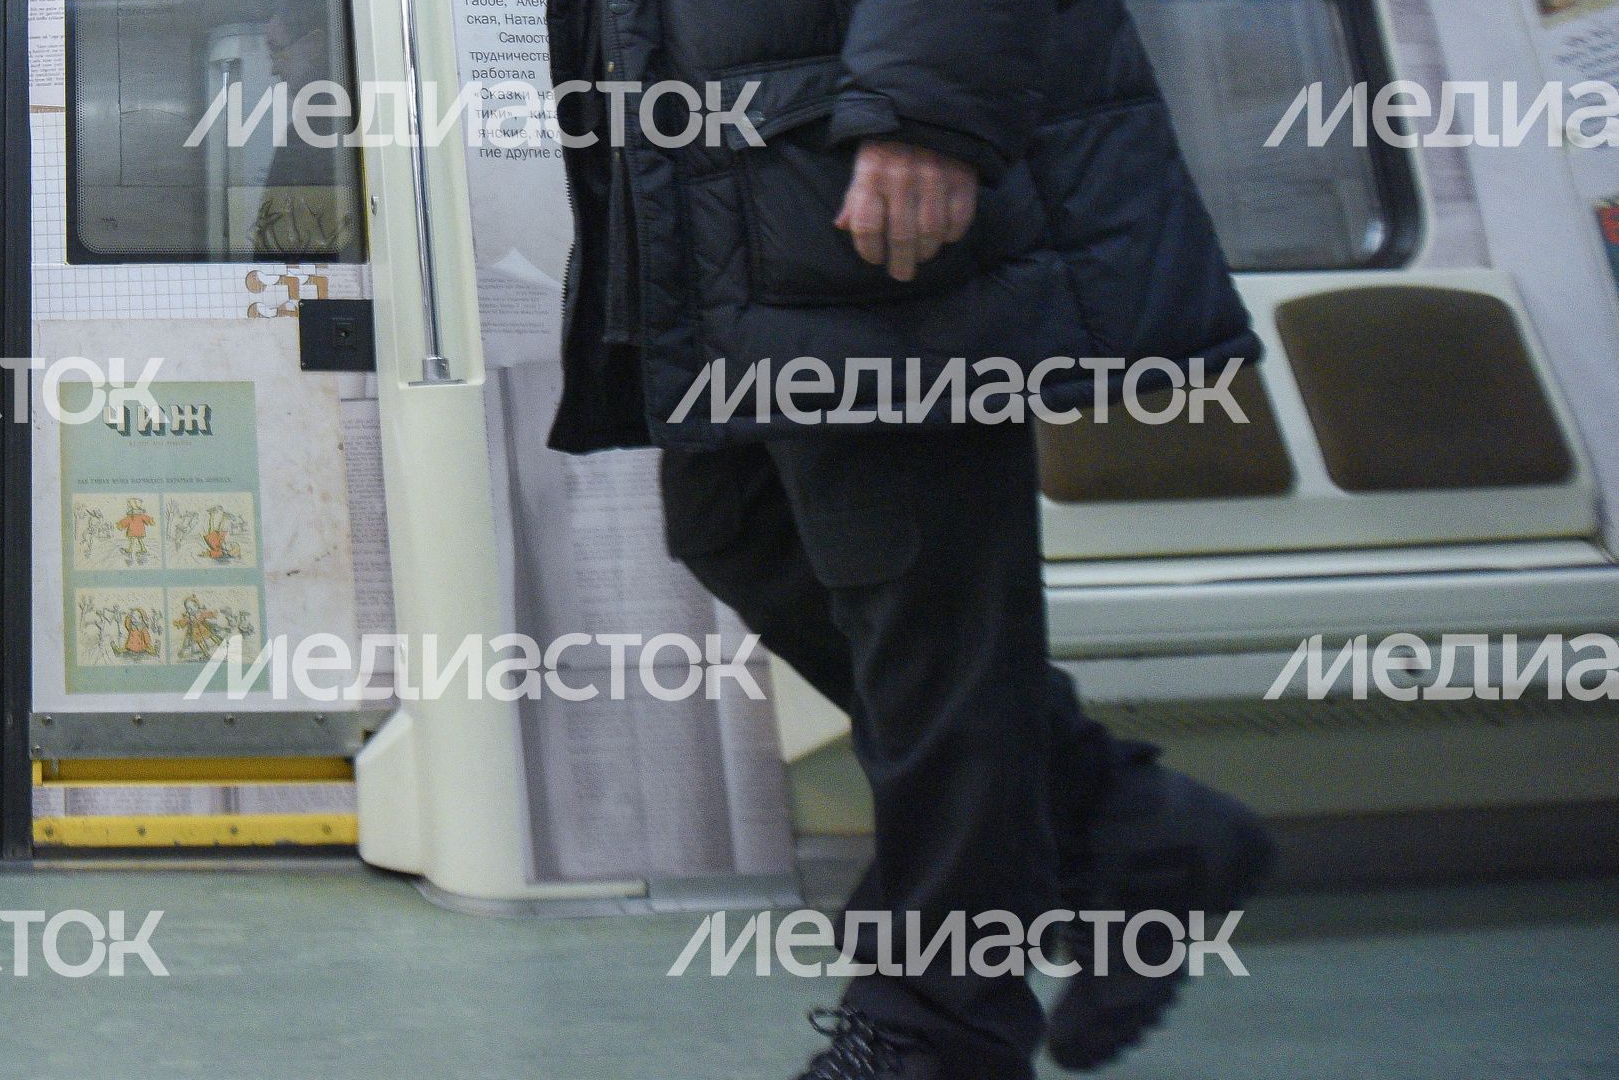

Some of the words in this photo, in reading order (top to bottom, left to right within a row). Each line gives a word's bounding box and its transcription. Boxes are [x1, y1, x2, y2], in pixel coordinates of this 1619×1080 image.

[467, 14, 501, 26] ская,
[472, 67, 536, 80] работала
[480, 147, 502, 158] гие
[506, 146, 551, 161] другие
[102, 403, 213, 437] ЧИЖ
